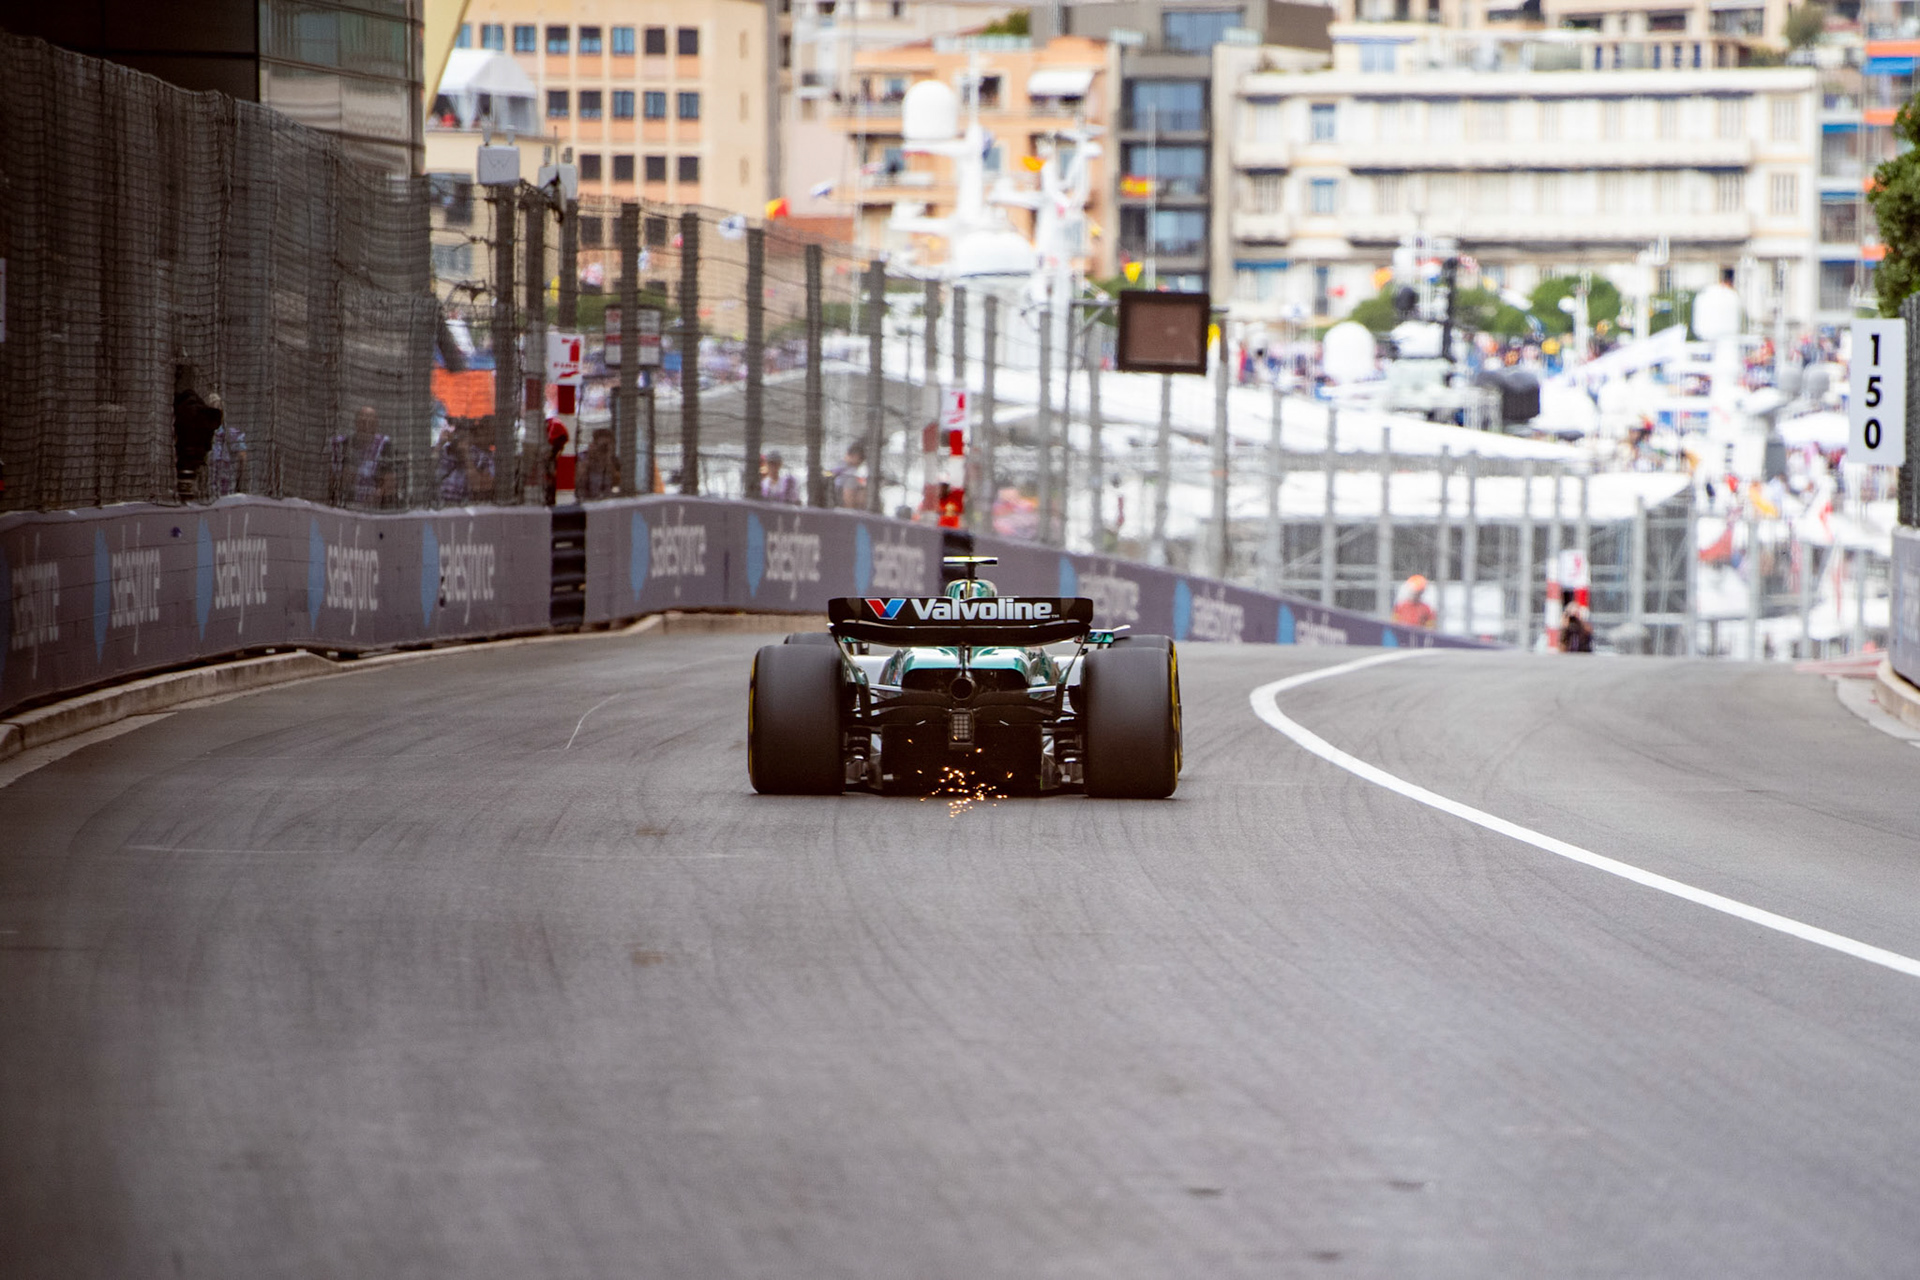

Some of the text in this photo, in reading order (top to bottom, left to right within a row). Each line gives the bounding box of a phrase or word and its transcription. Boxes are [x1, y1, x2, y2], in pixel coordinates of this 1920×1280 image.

[1864, 333, 1882, 449] 150
[215, 512, 268, 635] salesforce
[327, 523, 379, 636] salesforce
[439, 521, 495, 625] salesforce
[911, 598, 1053, 621] Valvoline
